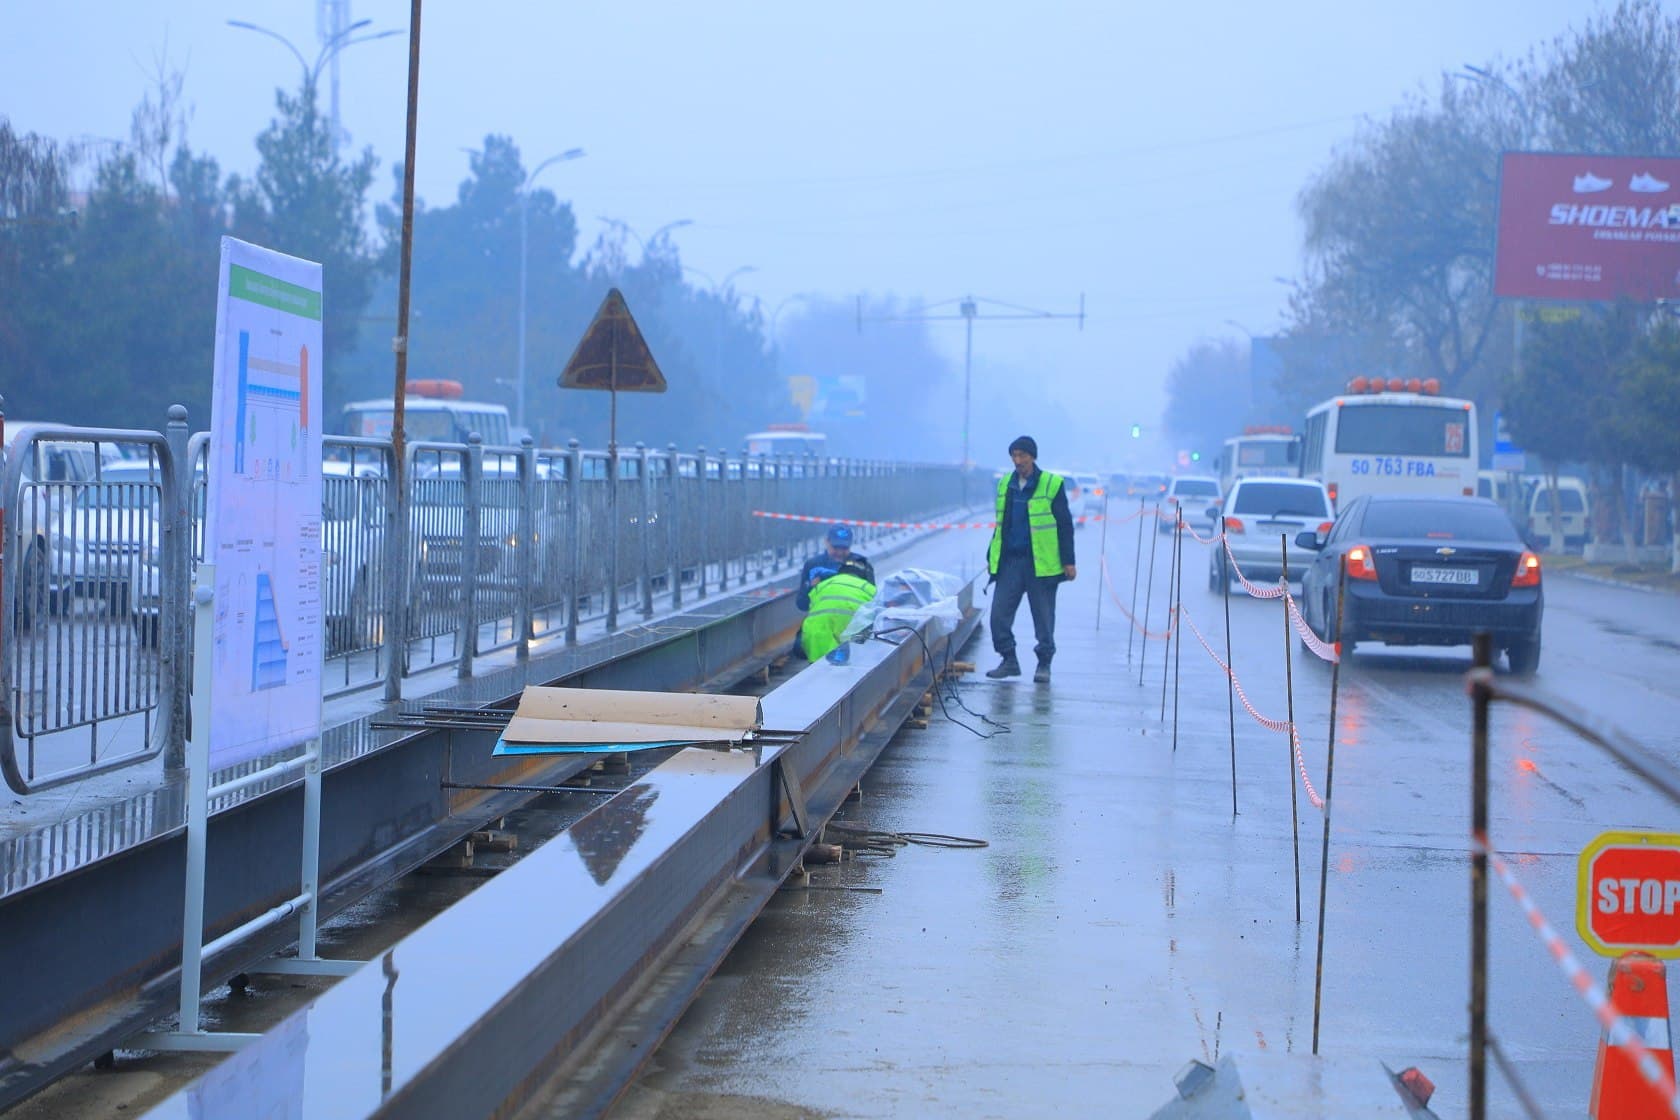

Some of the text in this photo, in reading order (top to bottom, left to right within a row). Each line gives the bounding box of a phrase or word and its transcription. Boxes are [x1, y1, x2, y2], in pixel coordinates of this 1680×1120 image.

[1351, 459, 1370, 474] 50
[1375, 457, 1402, 475] 763
[1407, 461, 1435, 477] FBA
[1597, 877, 1680, 915] STOP
